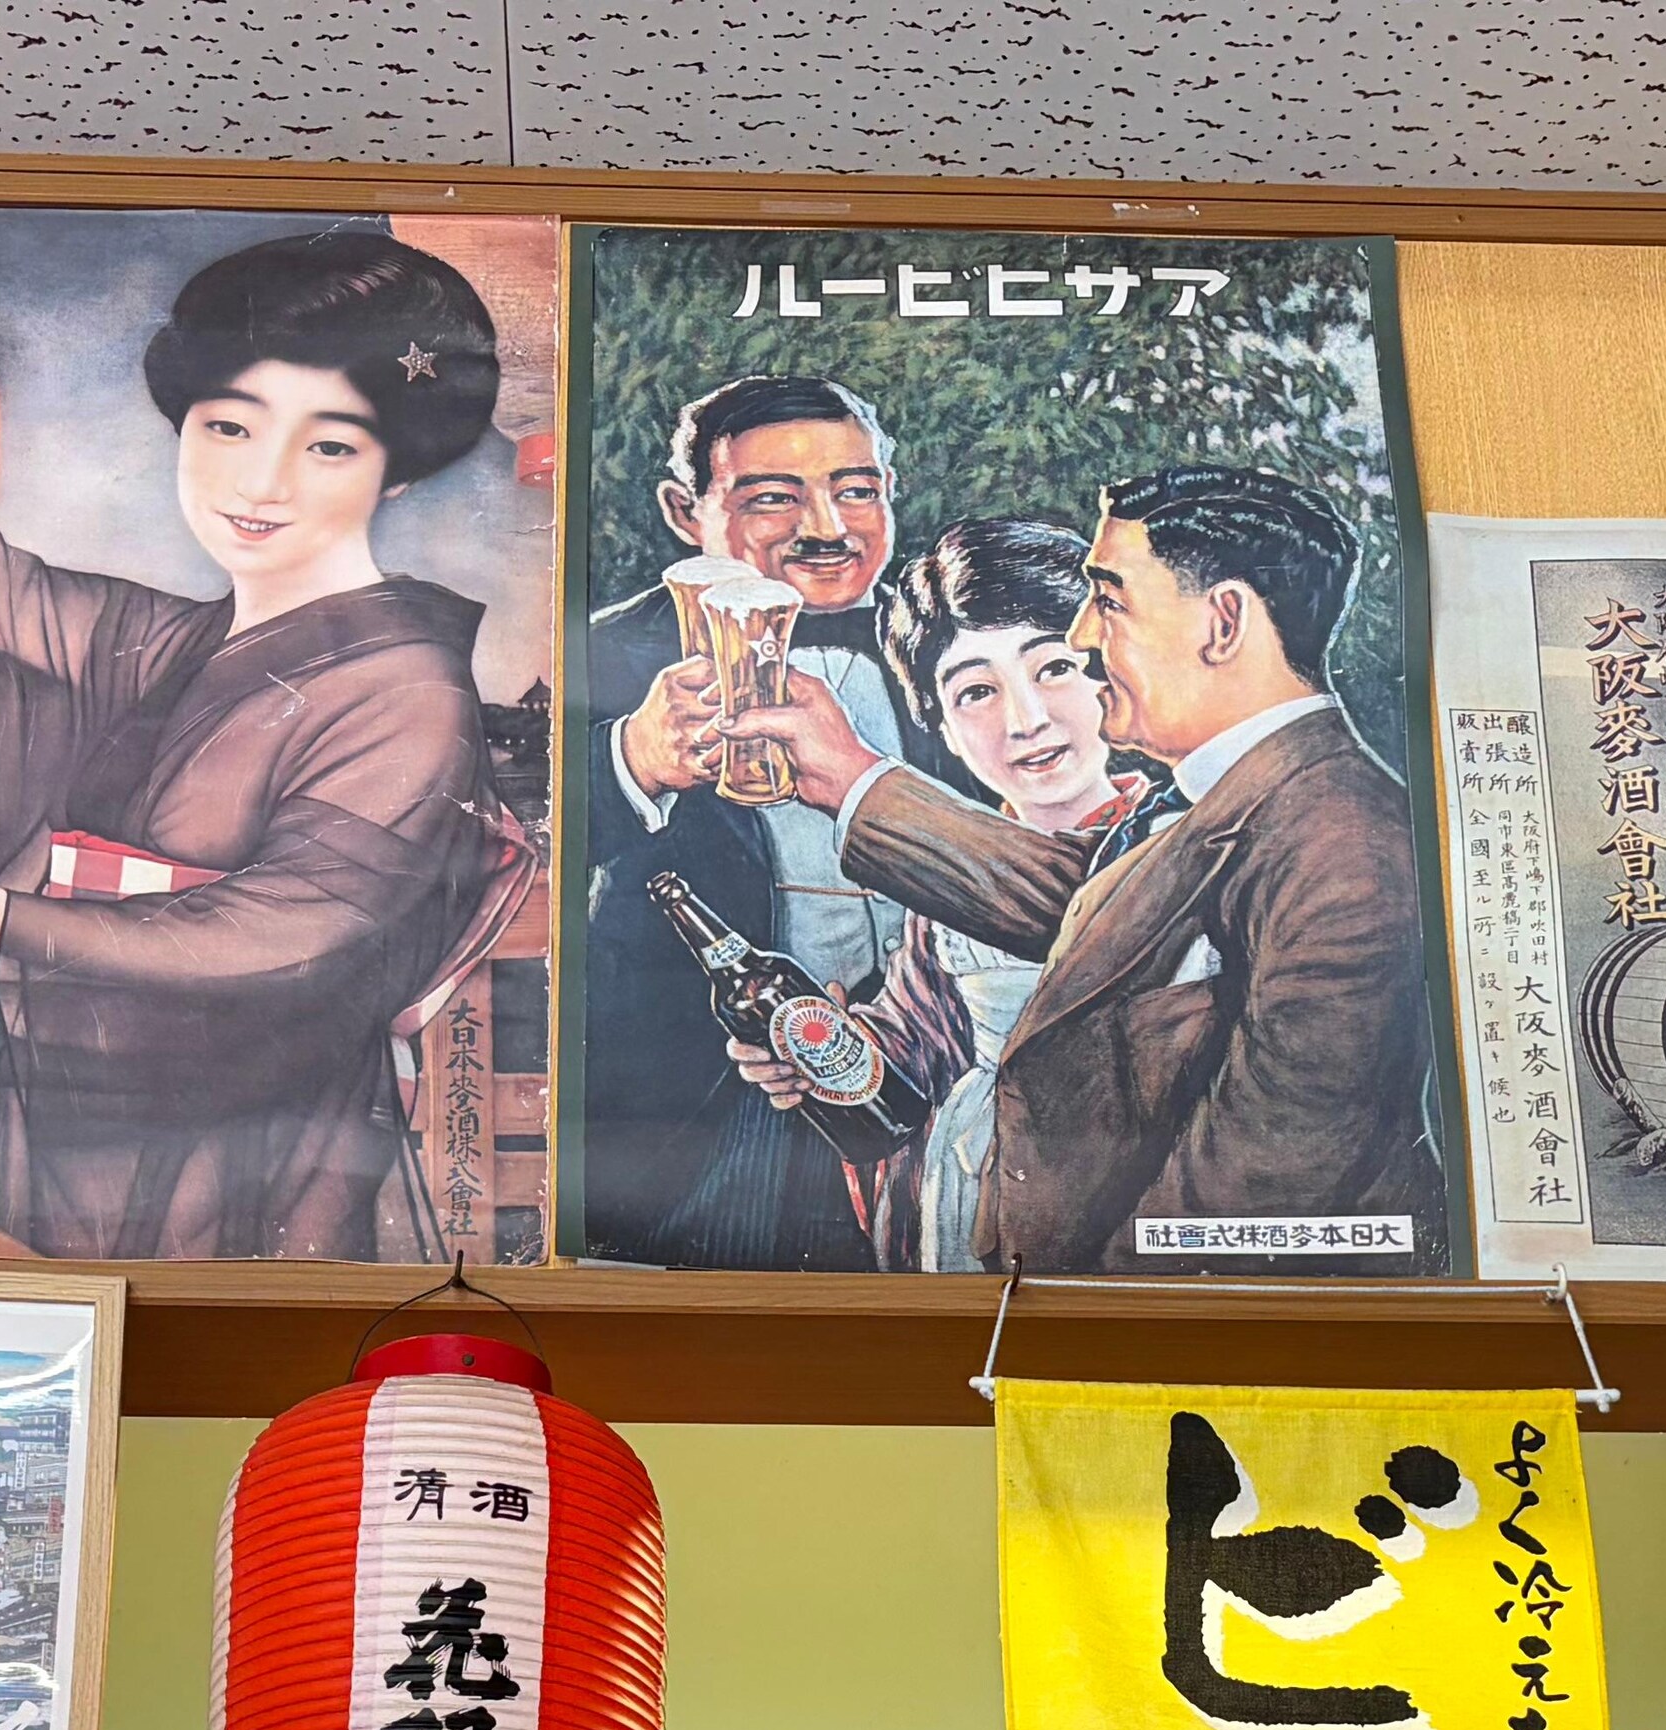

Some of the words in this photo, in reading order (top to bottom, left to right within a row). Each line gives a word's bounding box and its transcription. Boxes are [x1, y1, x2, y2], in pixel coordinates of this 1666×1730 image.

[733, 262, 1232, 319] アサヒビール
[393, 1467, 530, 1523] 清酒
